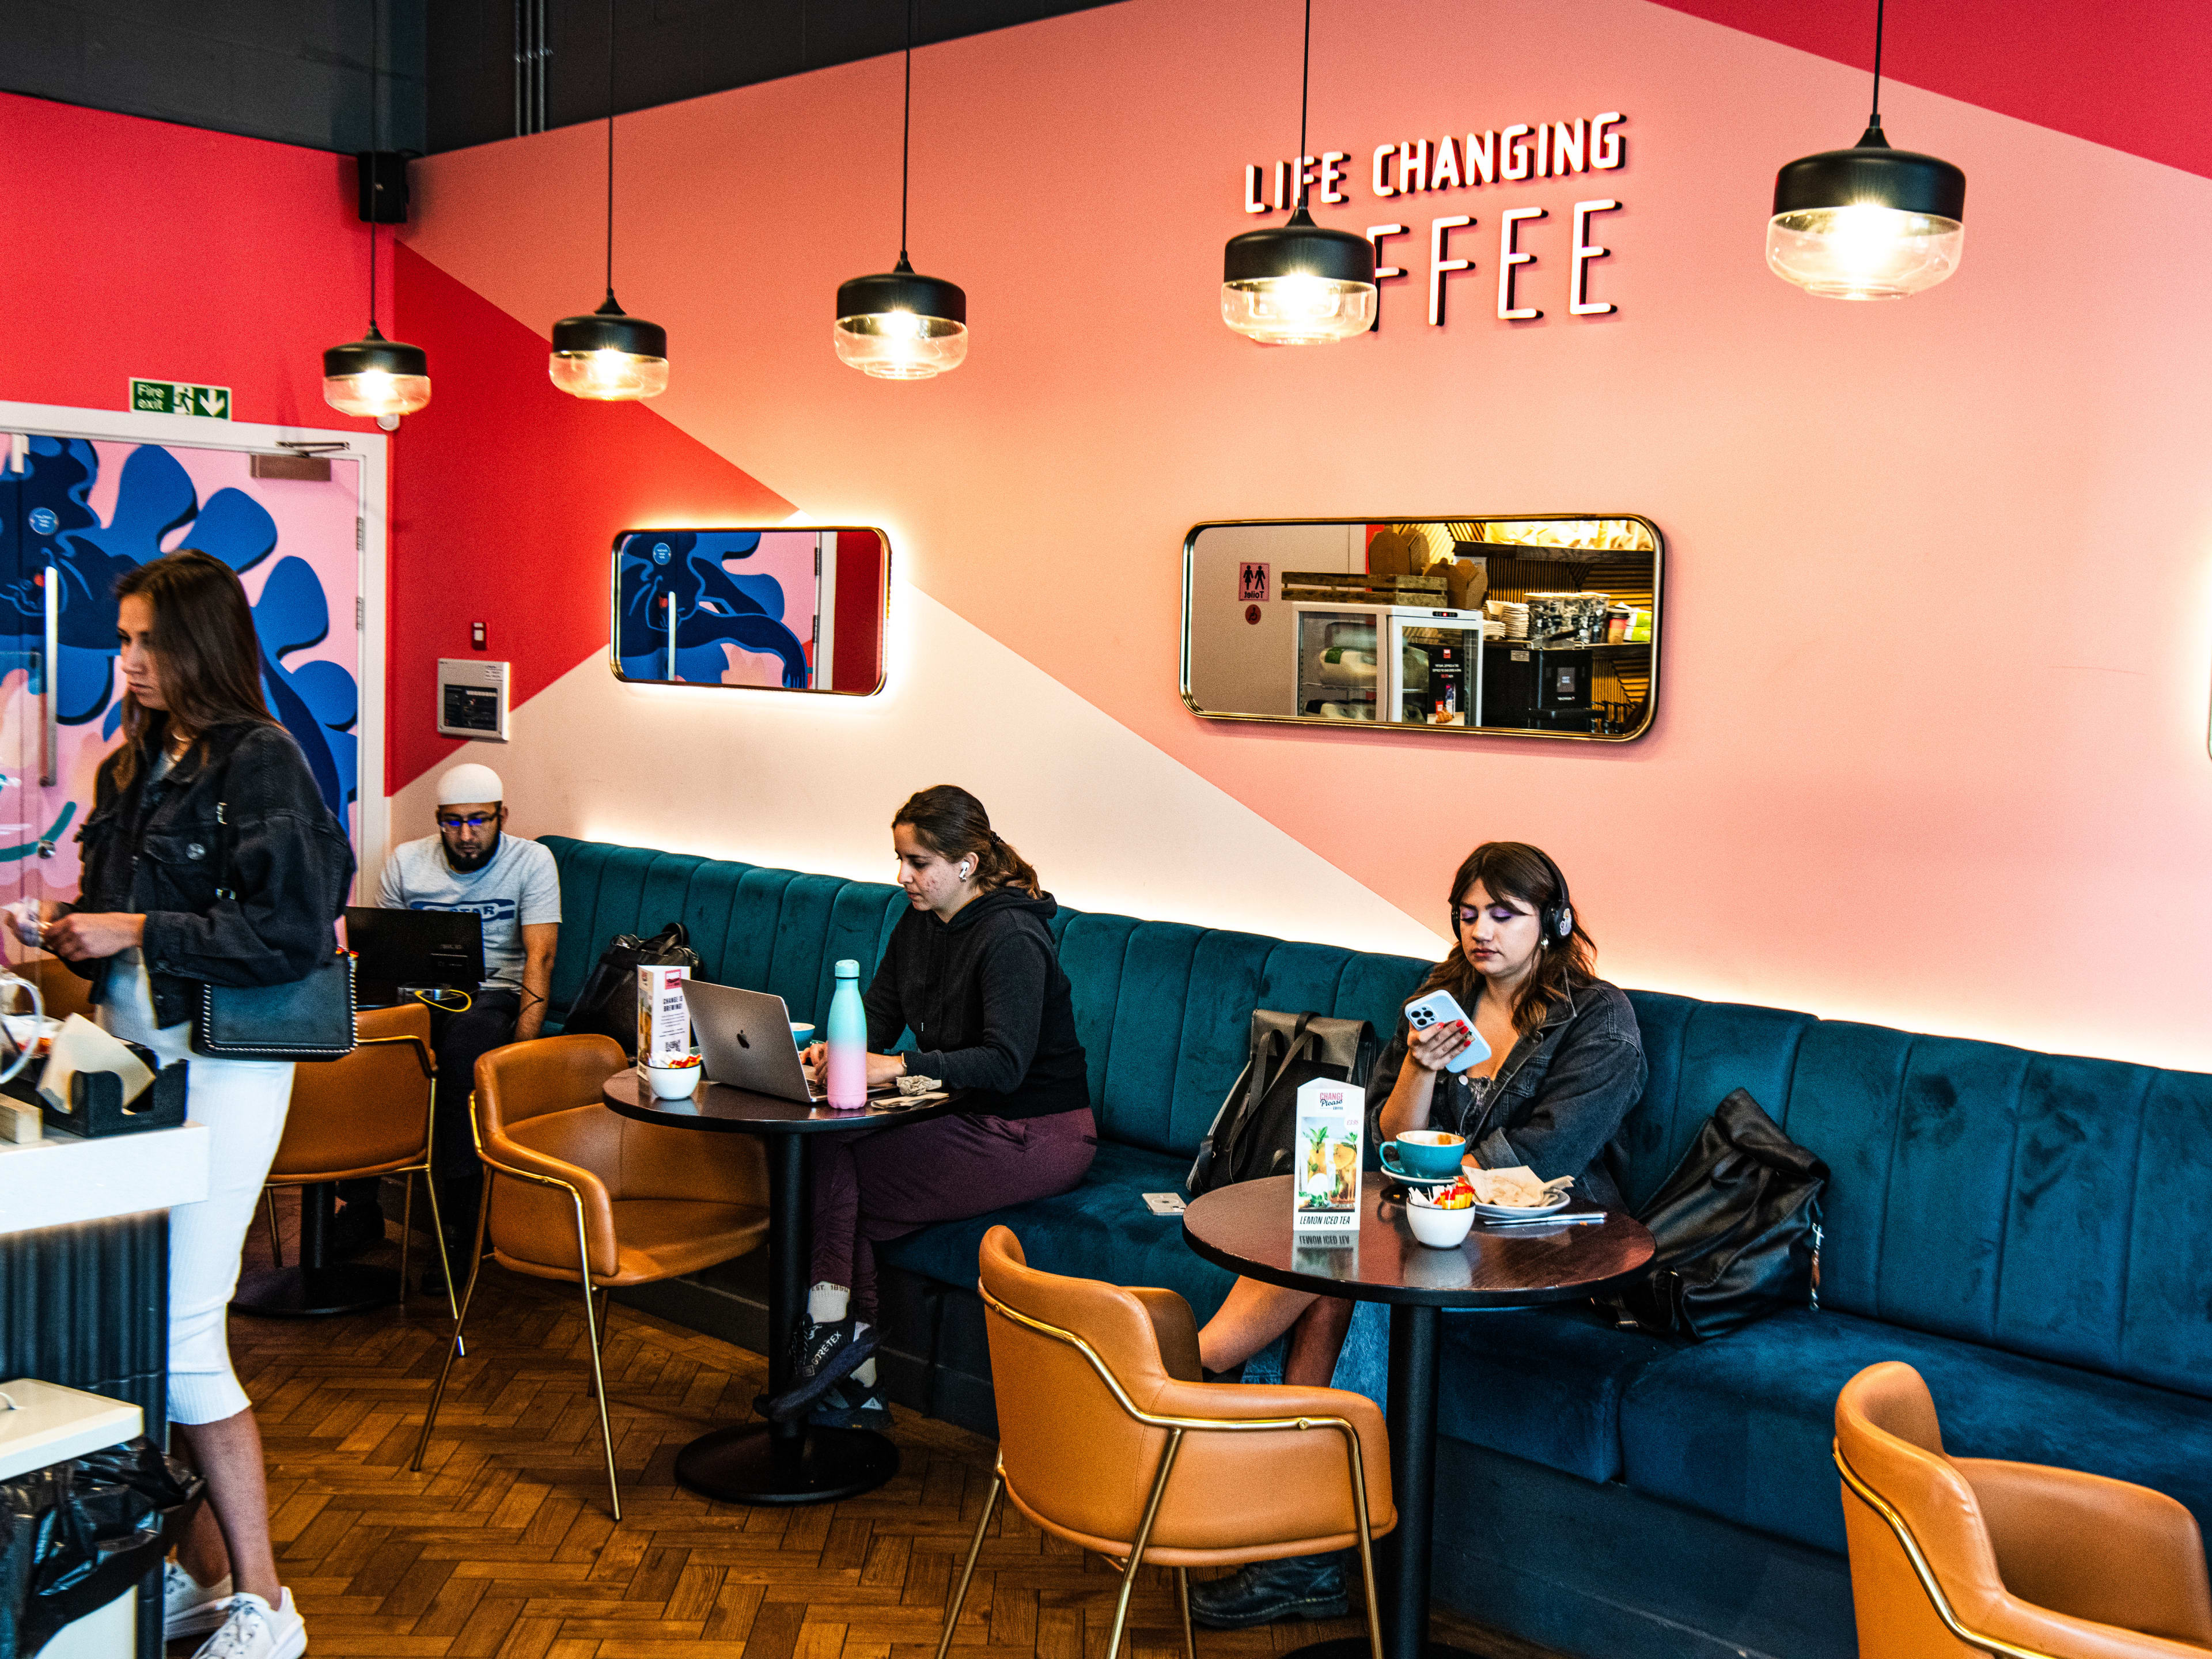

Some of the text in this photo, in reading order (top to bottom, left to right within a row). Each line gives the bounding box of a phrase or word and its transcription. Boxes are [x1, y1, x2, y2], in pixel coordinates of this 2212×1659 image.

[1245, 112, 1626, 214] LIFE CHANGING
[1366, 199, 1622, 332] FFEE
[138, 383, 165, 399] Fire
[138, 397, 164, 411] exit
[1320, 1092, 1343, 1100] CHANGE
[1320, 1097, 1343, 1107] Please
[1300, 1215, 1350, 1225] LEMON ICED TEA
